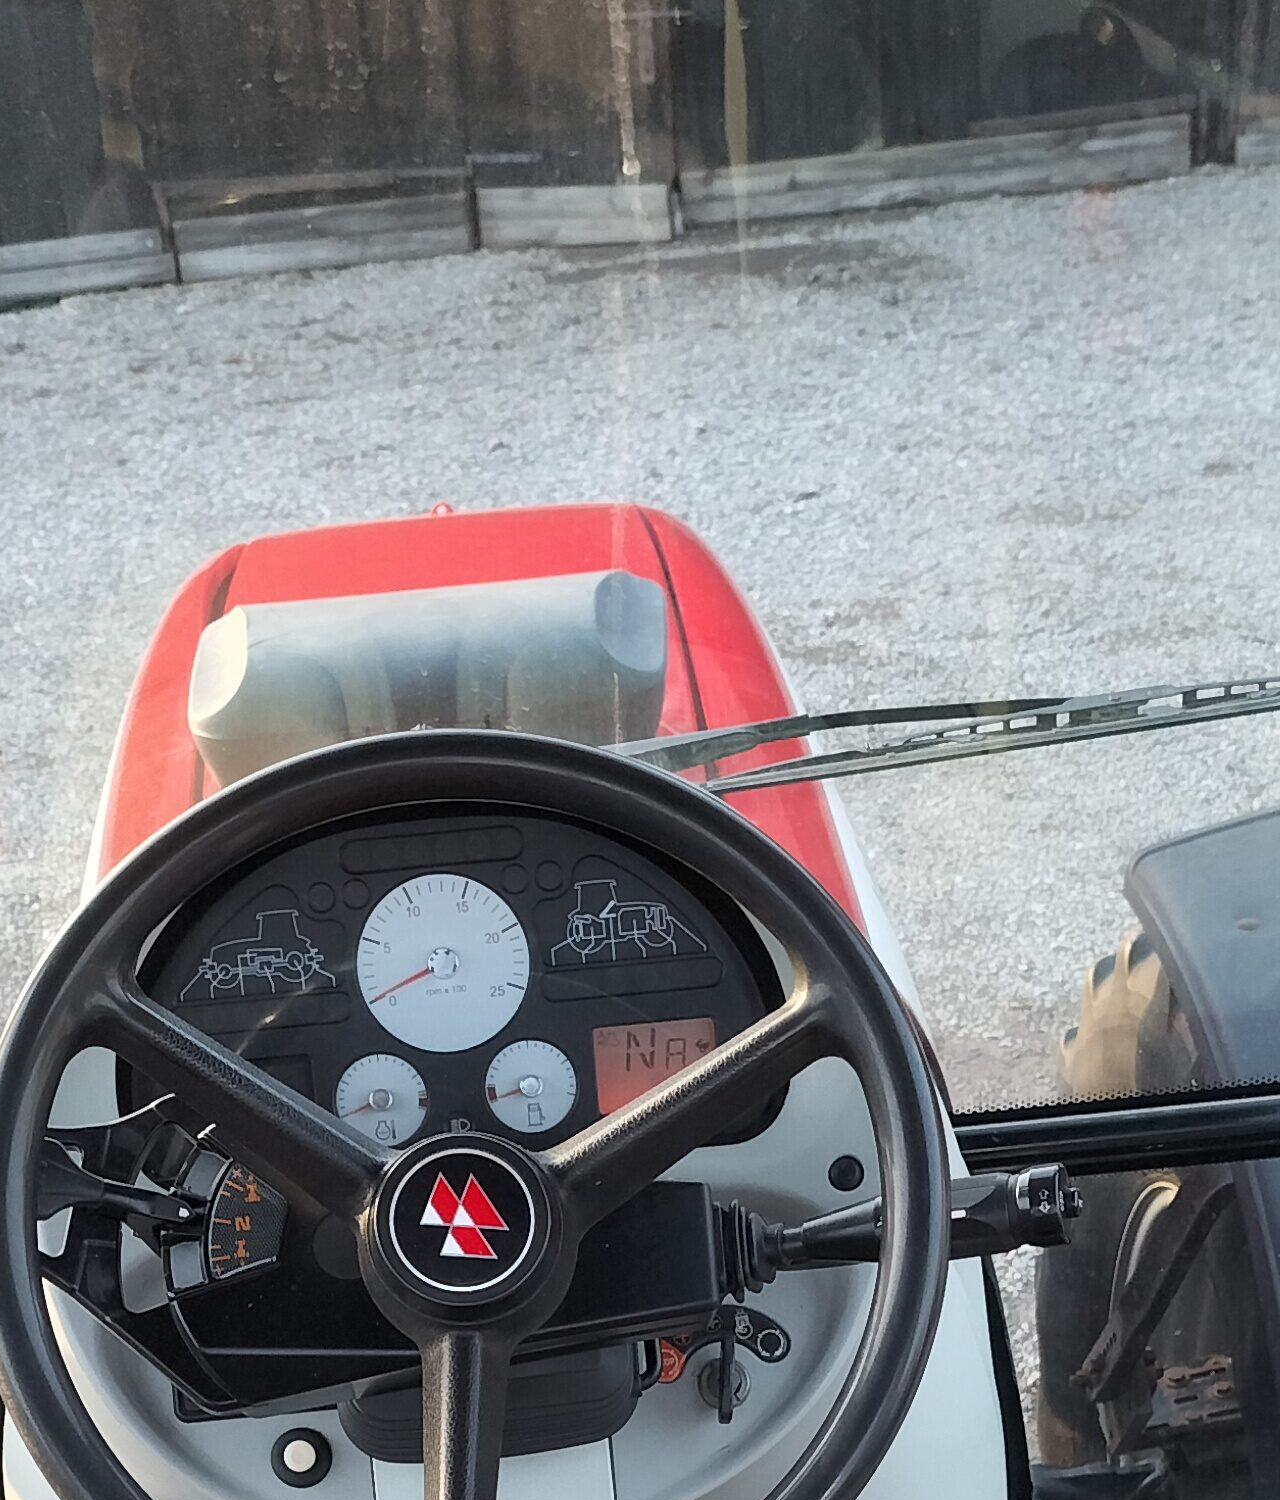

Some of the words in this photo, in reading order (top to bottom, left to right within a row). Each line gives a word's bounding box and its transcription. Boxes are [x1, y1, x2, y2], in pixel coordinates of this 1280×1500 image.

[406, 906, 420, 918] 10
[456, 901, 469, 913] 15
[484, 932, 500, 945] 20
[383, 942, 391, 954] 5
[426, 987, 442, 998] rpm
[489, 985, 505, 998] 25
[388, 996, 397, 1006] 0
